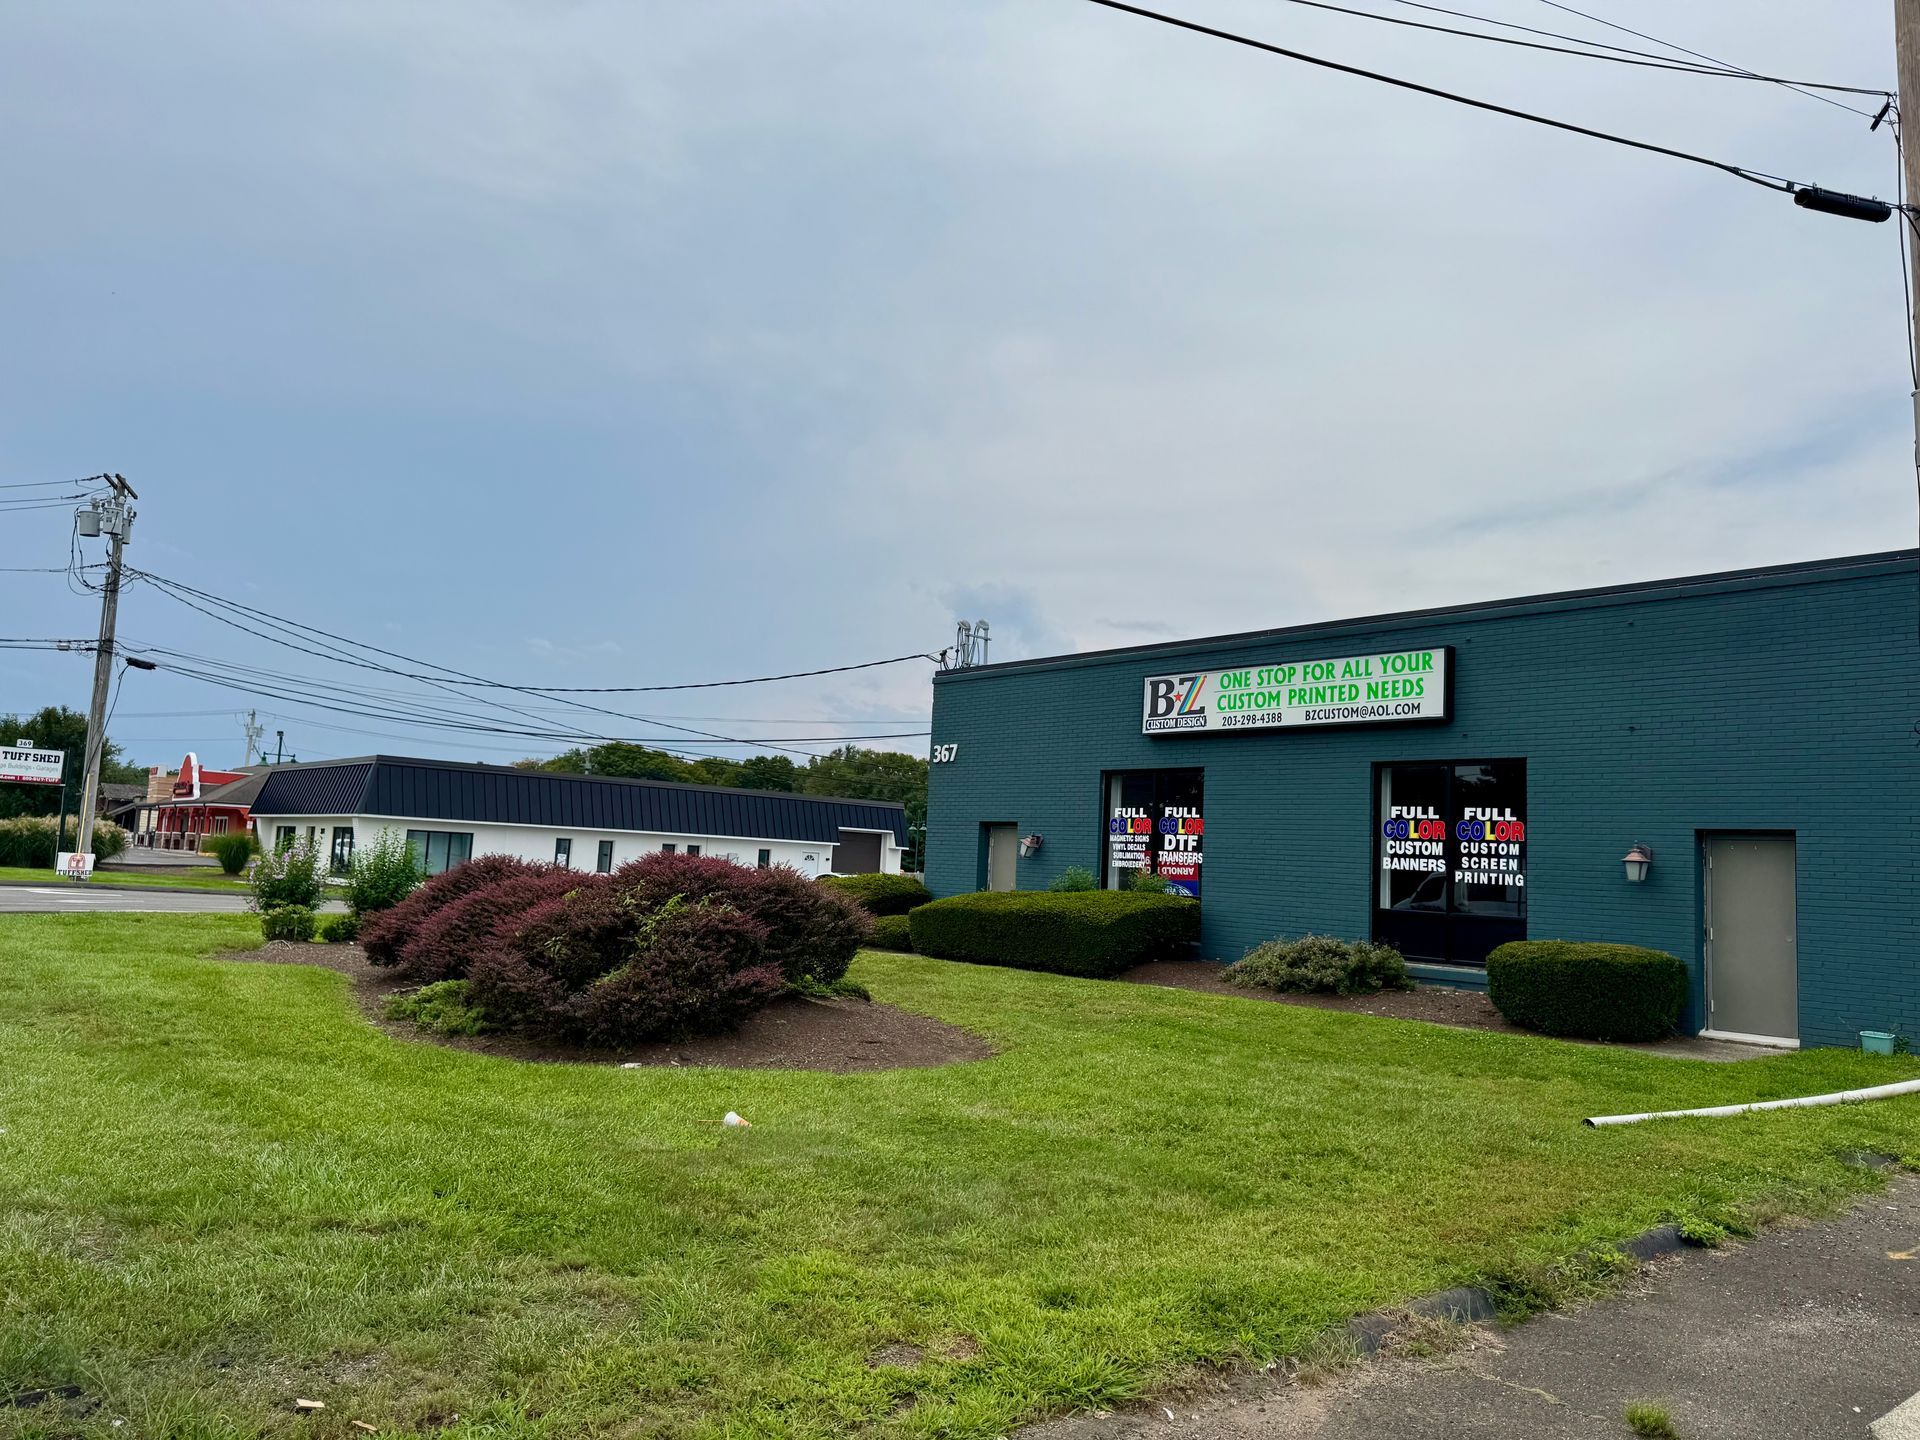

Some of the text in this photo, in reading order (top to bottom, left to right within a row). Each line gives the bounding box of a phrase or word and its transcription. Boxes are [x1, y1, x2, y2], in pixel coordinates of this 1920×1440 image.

[1220, 652, 1434, 689] ONE STOP FOR ALL YOUR
[1217, 677, 1424, 711] CUSTOM PRINTED NEEDS
[1305, 702, 1421, 721] BZCUSTOM@AOL.COM
[1146, 715, 1207, 730] CUSTOM DESIGN
[1222, 712, 1282, 727] 203-298-4388
[2, 750, 61, 764] TUFF SHED
[933, 743, 958, 763] 367
[1114, 807, 1147, 818] FULL
[1165, 807, 1200, 818] FULL
[1391, 806, 1439, 819] FULL
[1464, 807, 1517, 821] FULL
[1109, 818, 1152, 834] COLOR
[1159, 818, 1204, 835] COLOR
[1383, 819, 1446, 840] COLOR
[1456, 820, 1525, 842] COLOR
[1134, 835, 1150, 843] SIGNS
[1164, 834, 1199, 851] DTF
[1127, 843, 1146, 851] DECALS
[1386, 841, 1443, 856] CUSTOM
[1460, 842, 1520, 856] CUSTOM
[1112, 851, 1145, 860] SUBLIMATION
[1158, 851, 1203, 864] TRANSFERS
[1382, 857, 1446, 872] BANNERS
[1461, 857, 1518, 871] SCREEN
[1455, 871, 1524, 887] PRINTING
